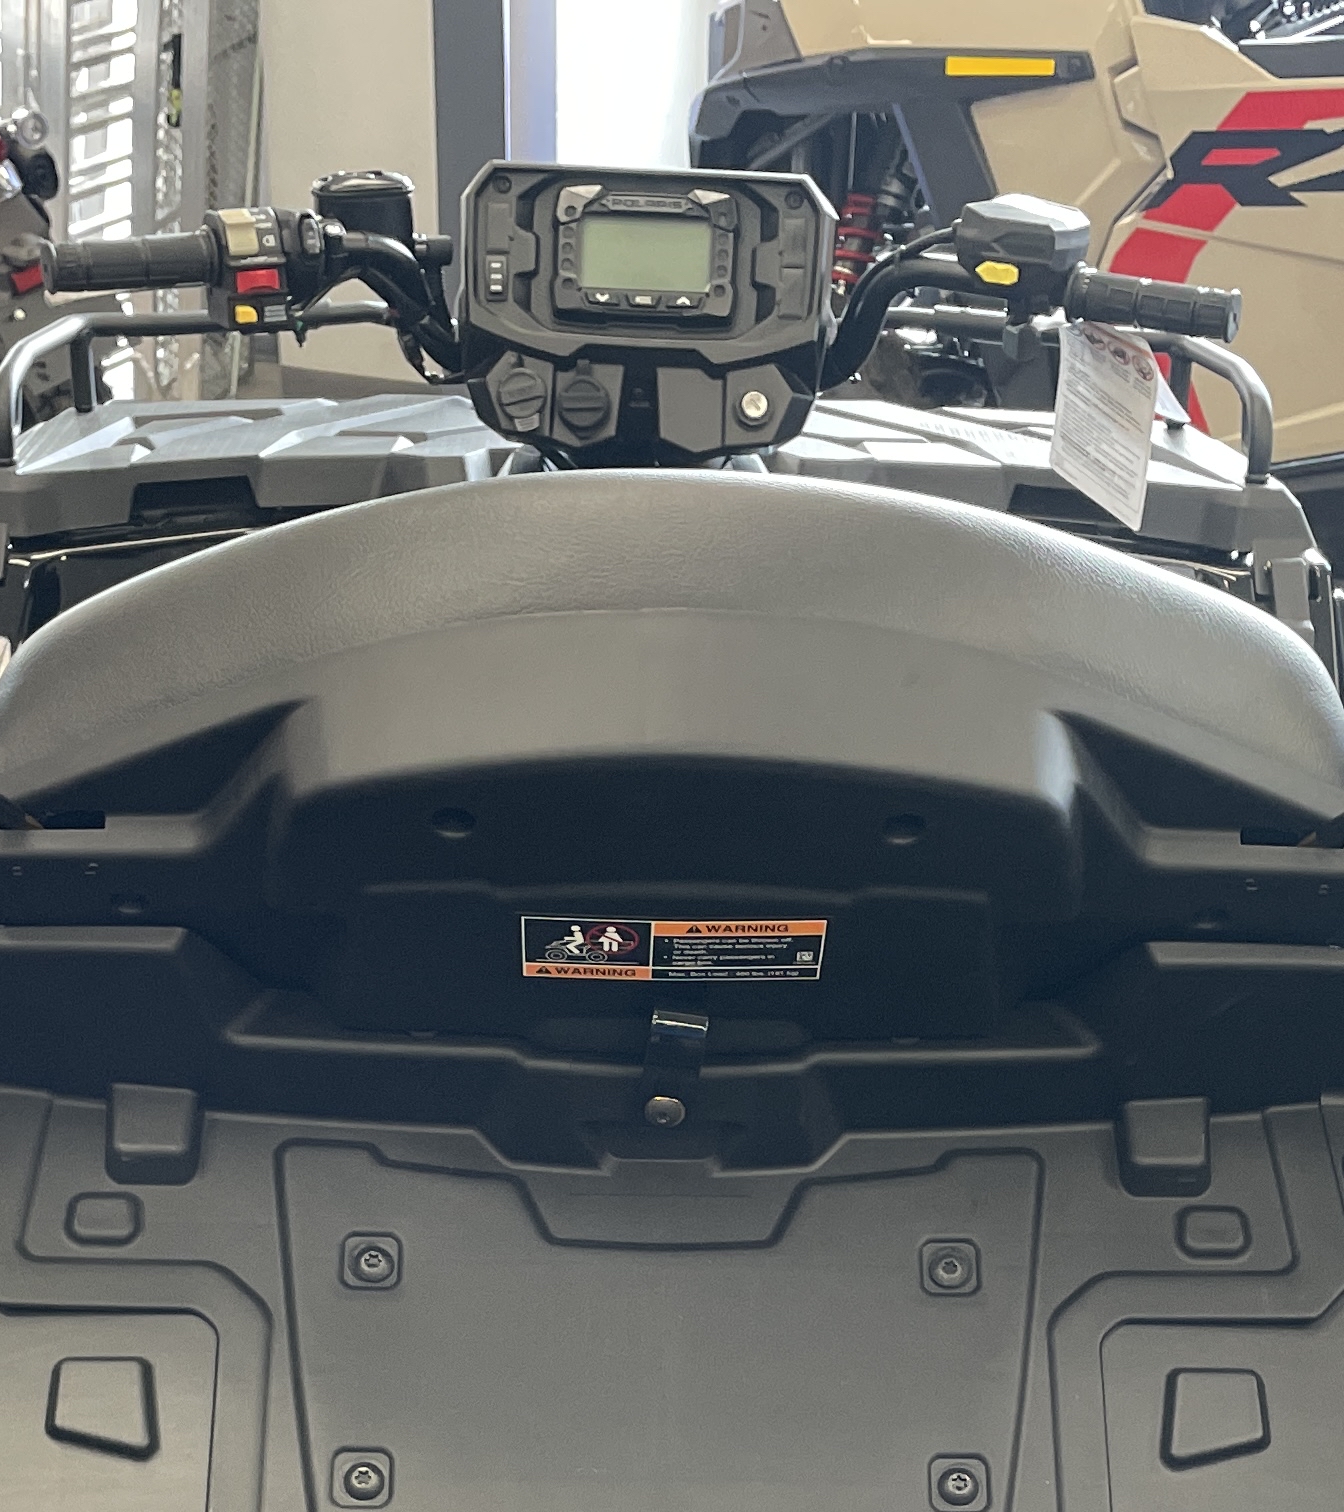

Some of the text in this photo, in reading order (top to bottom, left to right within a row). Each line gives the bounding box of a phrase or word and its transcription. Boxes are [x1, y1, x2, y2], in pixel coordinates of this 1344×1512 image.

[611, 198, 683, 210] POLARIS
[705, 923, 789, 933] WARNING
[556, 966, 636, 977] WARNING
